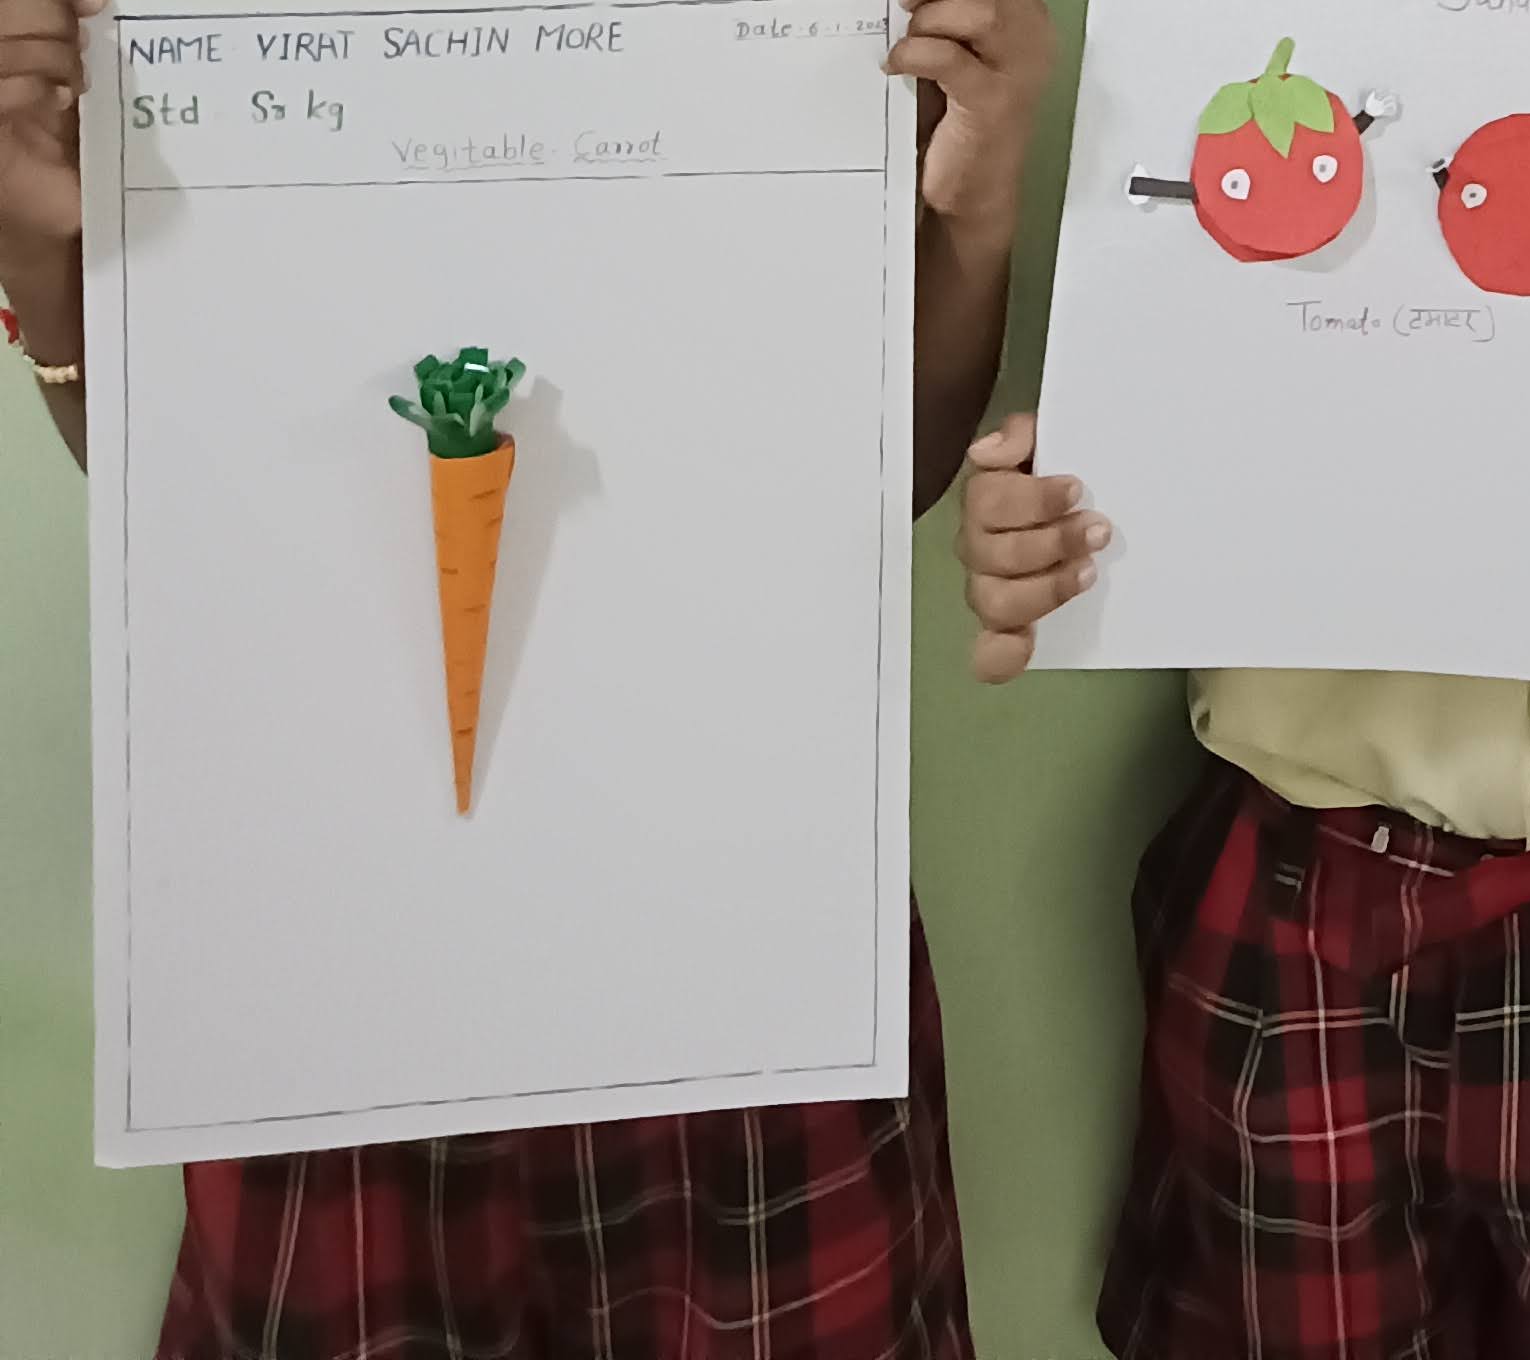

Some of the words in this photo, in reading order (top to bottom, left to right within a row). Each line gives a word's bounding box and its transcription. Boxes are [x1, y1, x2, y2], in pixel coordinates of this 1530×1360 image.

[129, 33, 223, 65] NAME
[256, 30, 354, 63] VIRAT
[384, 26, 510, 59] SACHIN
[535, 20, 625, 53] MORE
[736, 17, 793, 39] Date
[132, 92, 200, 130] Std
[306, 88, 345, 131] kg
[1285, 298, 1382, 337] Tomato
